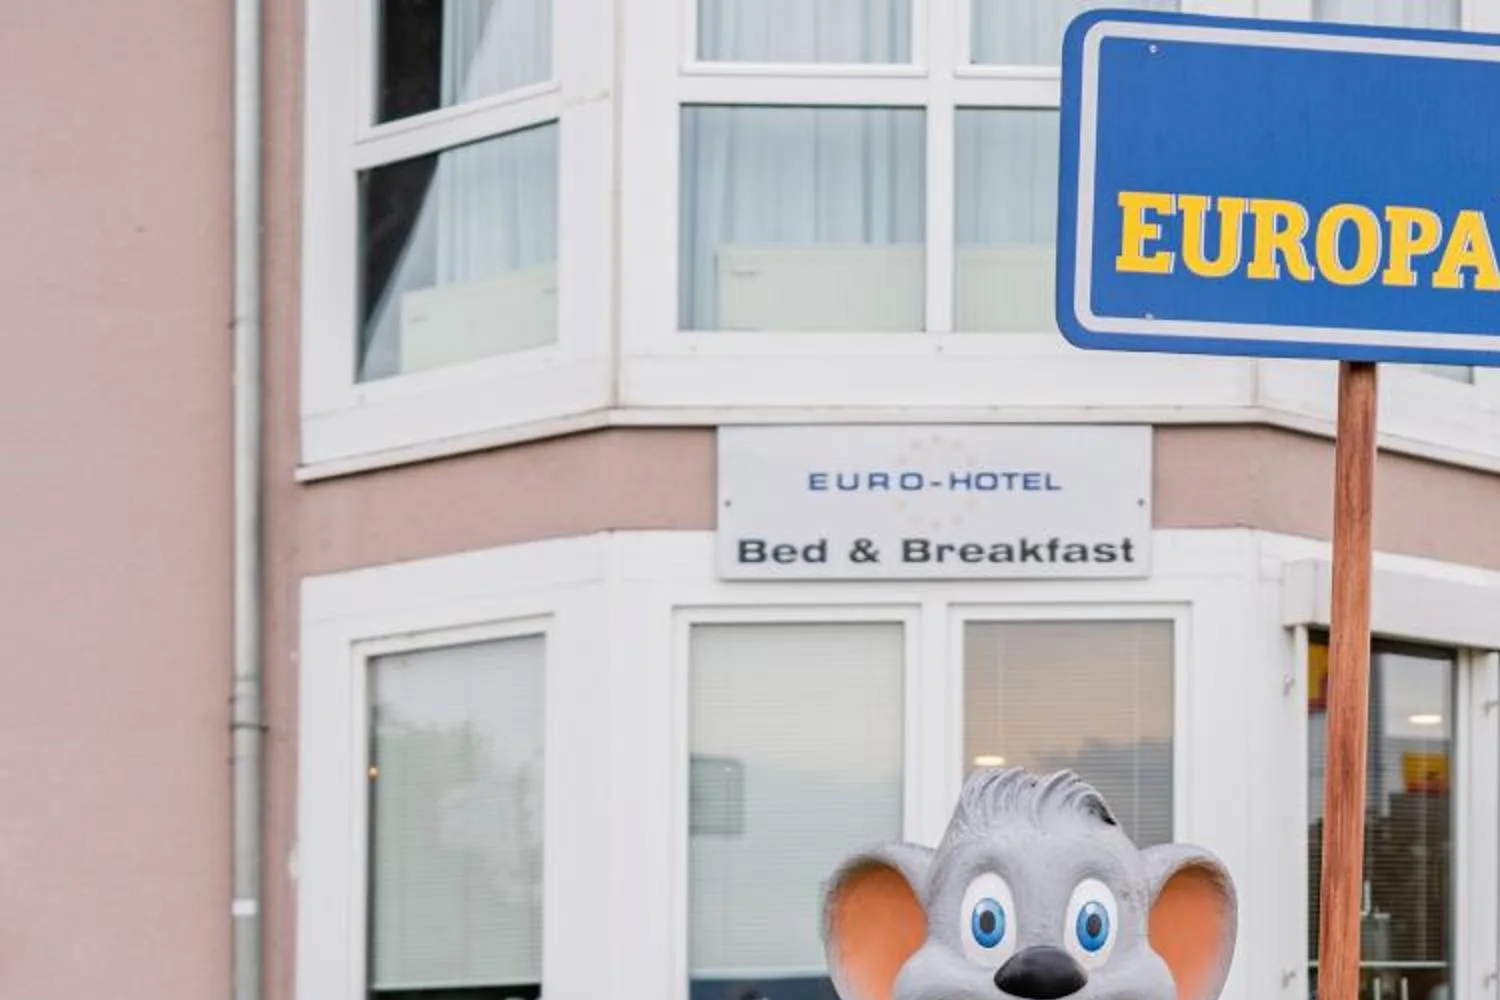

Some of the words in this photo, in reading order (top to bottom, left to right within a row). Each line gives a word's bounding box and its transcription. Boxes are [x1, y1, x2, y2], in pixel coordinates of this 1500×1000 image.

[808, 472, 1064, 491] EURO-HOTEL
[738, 538, 828, 564] Bed
[849, 539, 881, 564] &
[902, 537, 1136, 564] Breakfast
